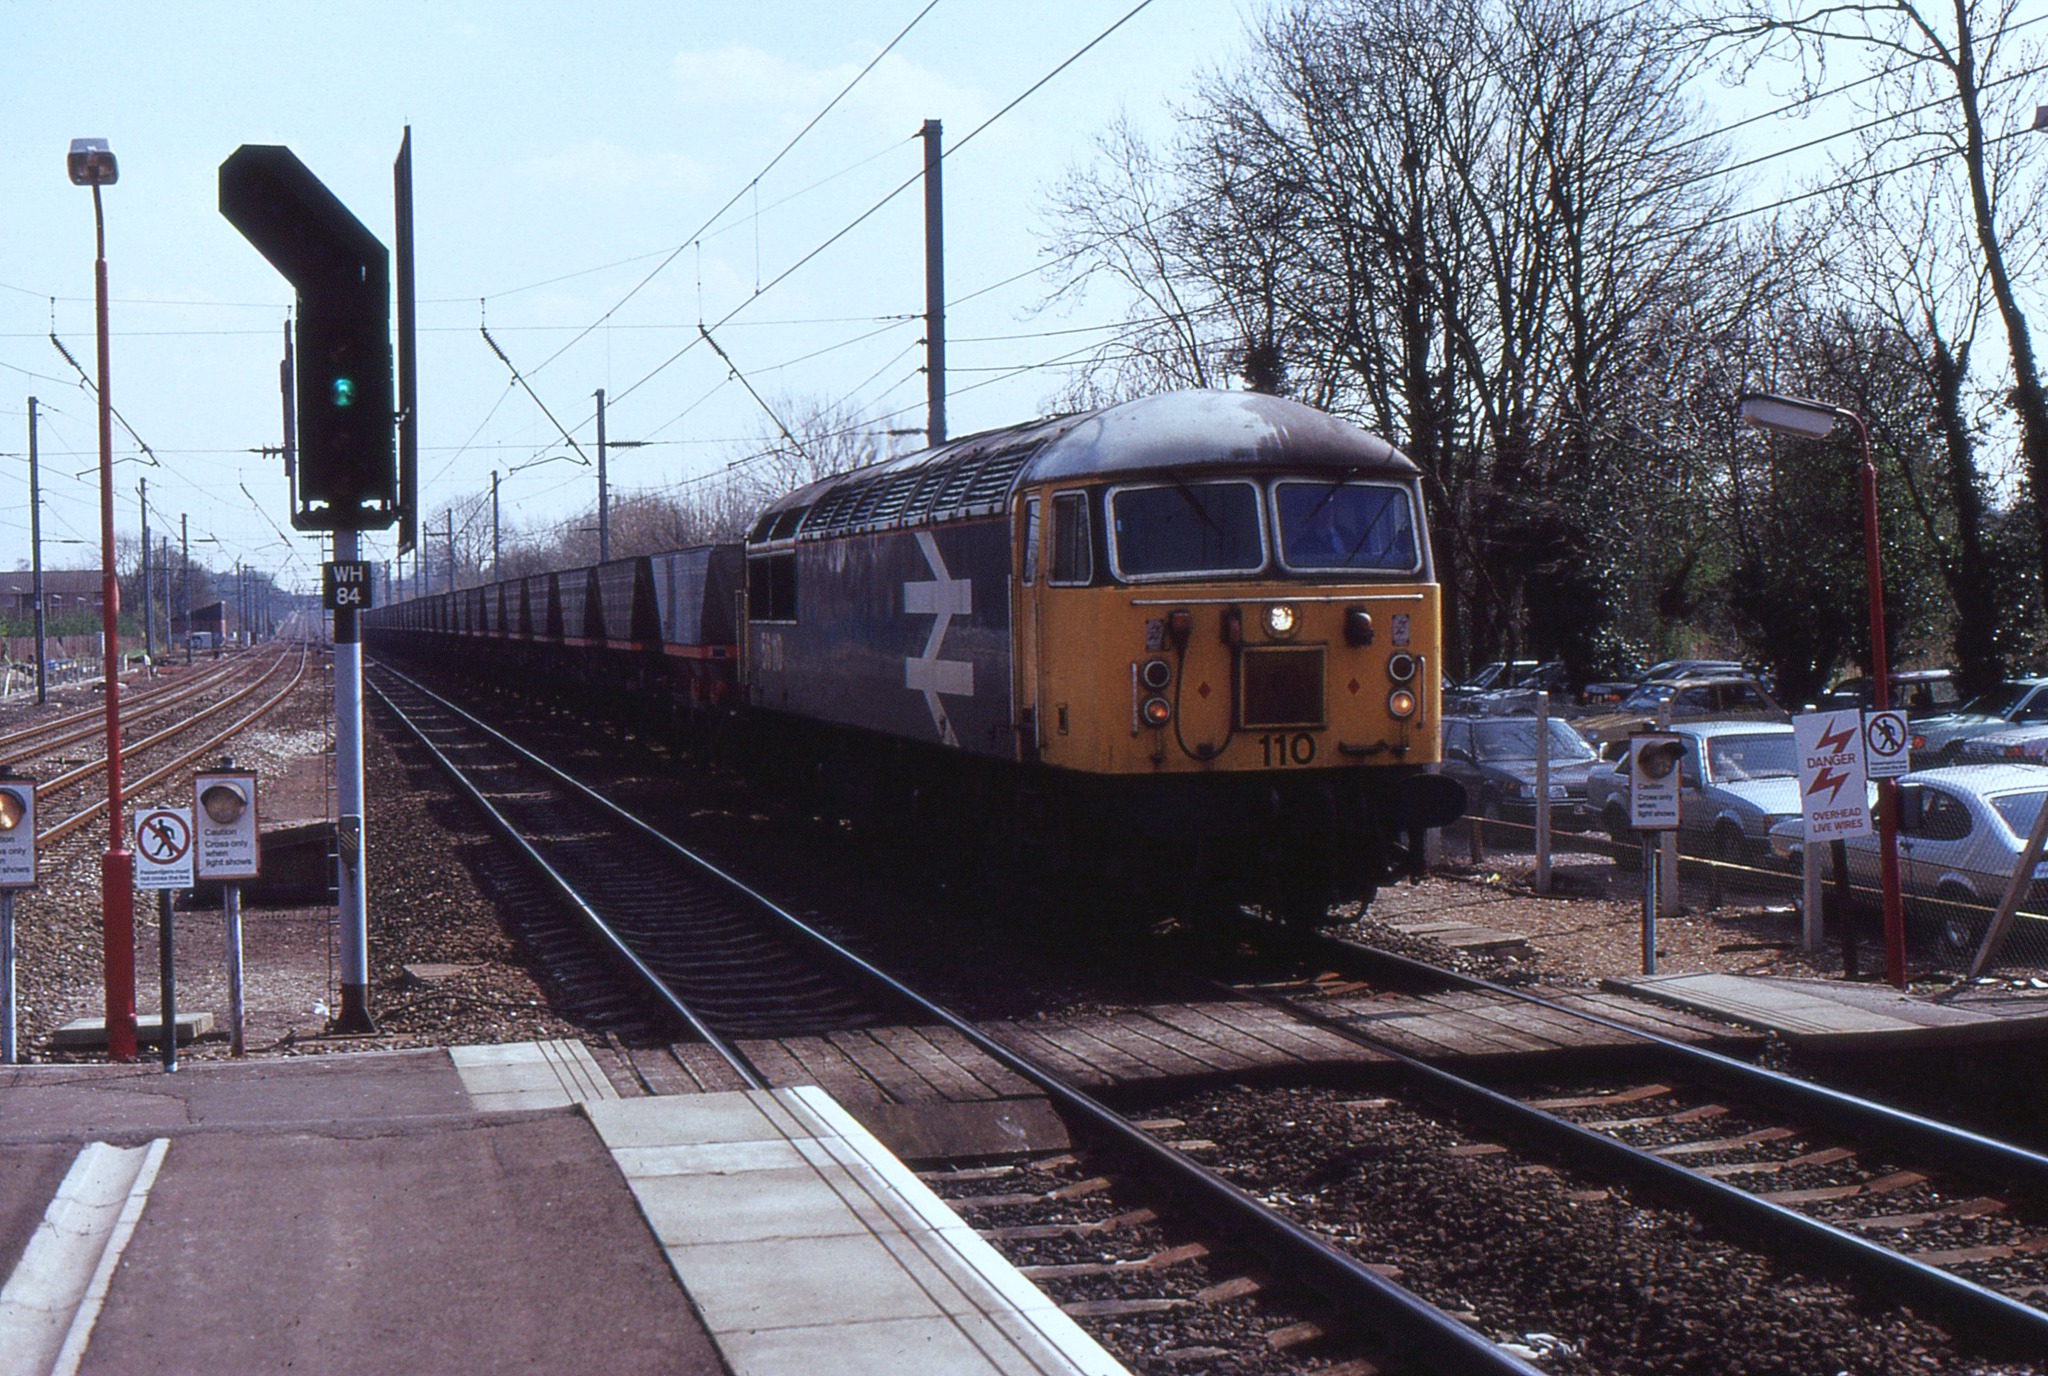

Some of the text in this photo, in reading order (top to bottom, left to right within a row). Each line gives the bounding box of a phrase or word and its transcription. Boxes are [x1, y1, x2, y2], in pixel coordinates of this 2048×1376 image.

[333, 566, 363, 582] WH
[336, 587, 361, 605] 84
[1259, 733, 1316, 767] 110
[1806, 753, 1856, 769] DANGER
[1812, 807, 1862, 821] OVERHEAD
[204, 828, 237, 837] Caution
[1812, 819, 1864, 833] LIVE WIRES
[204, 840, 248, 849] Cross only
[205, 859, 224, 868] light
